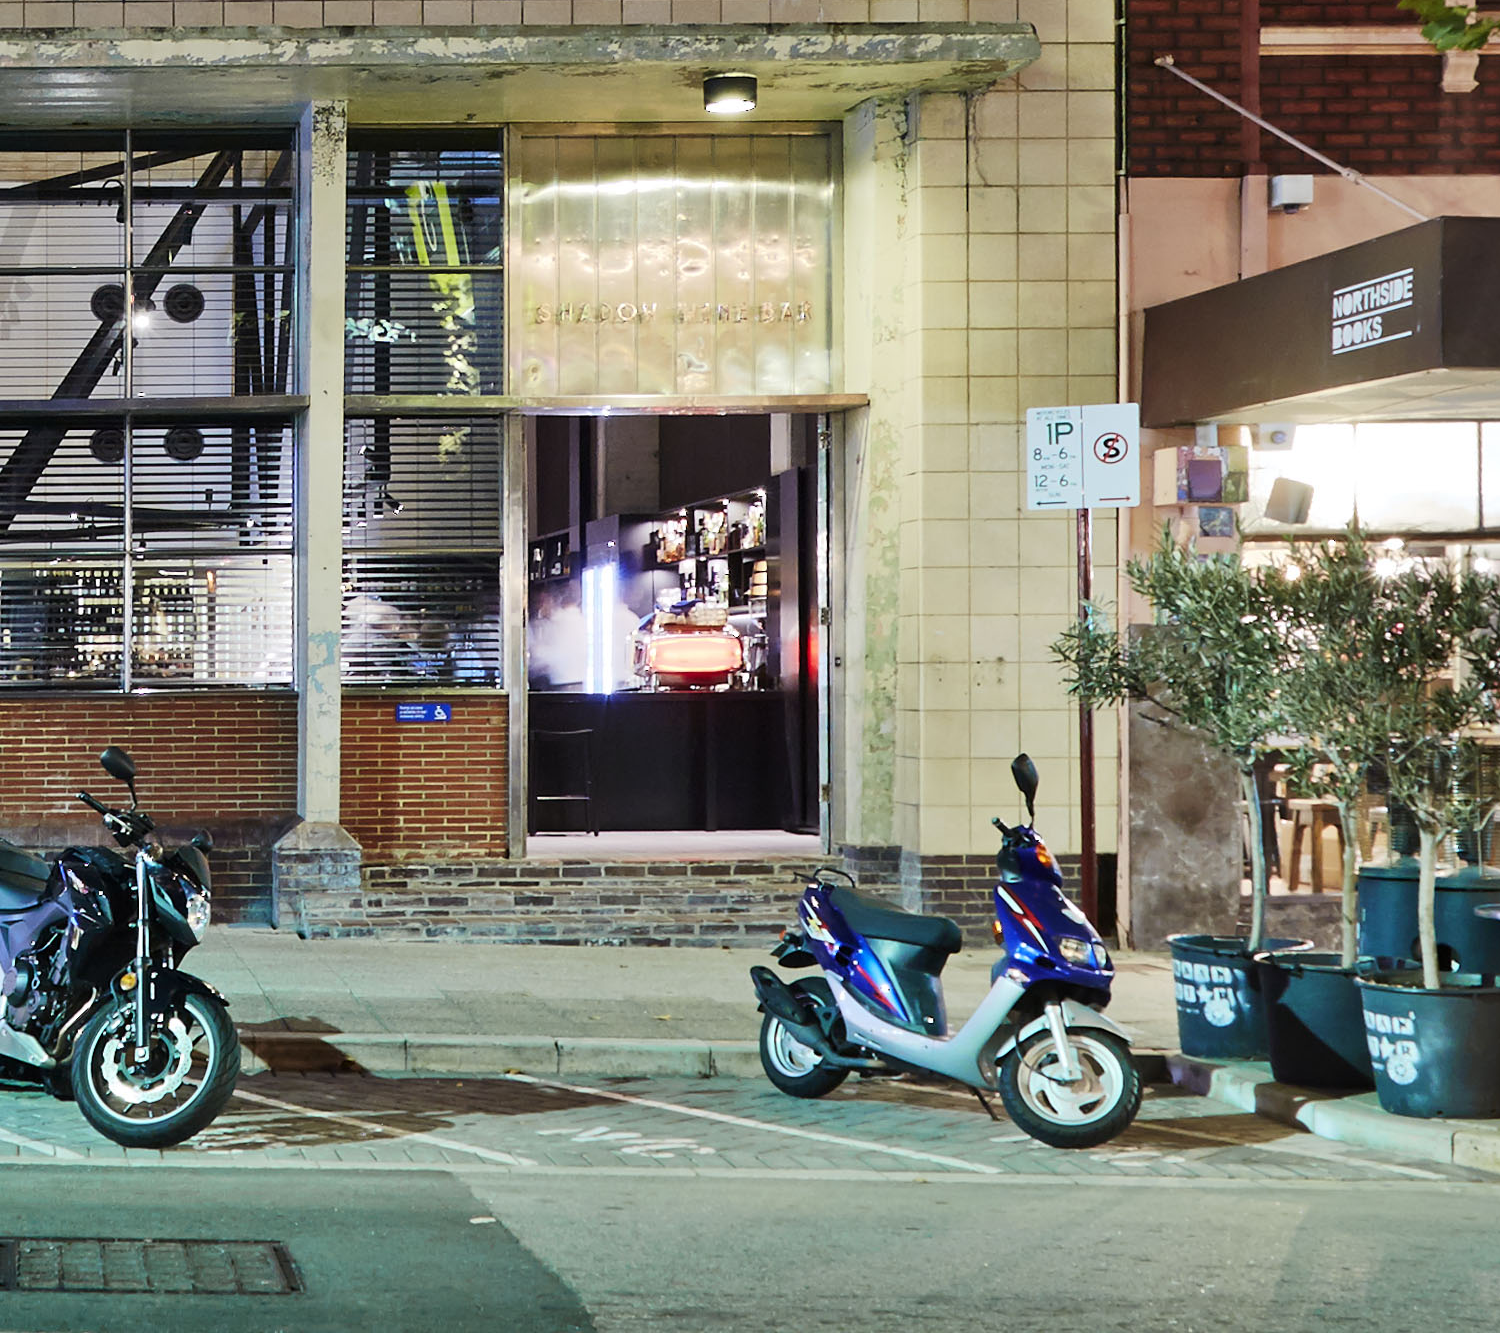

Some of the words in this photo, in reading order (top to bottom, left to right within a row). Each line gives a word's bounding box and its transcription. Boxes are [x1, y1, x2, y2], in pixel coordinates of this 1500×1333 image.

[1332, 274, 1414, 319] NORTHSIDE
[534, 302, 658, 324] SHADOW
[757, 301, 813, 324] BAR
[1332, 316, 1383, 350] BOOKS
[1046, 422, 1074, 445] 1P
